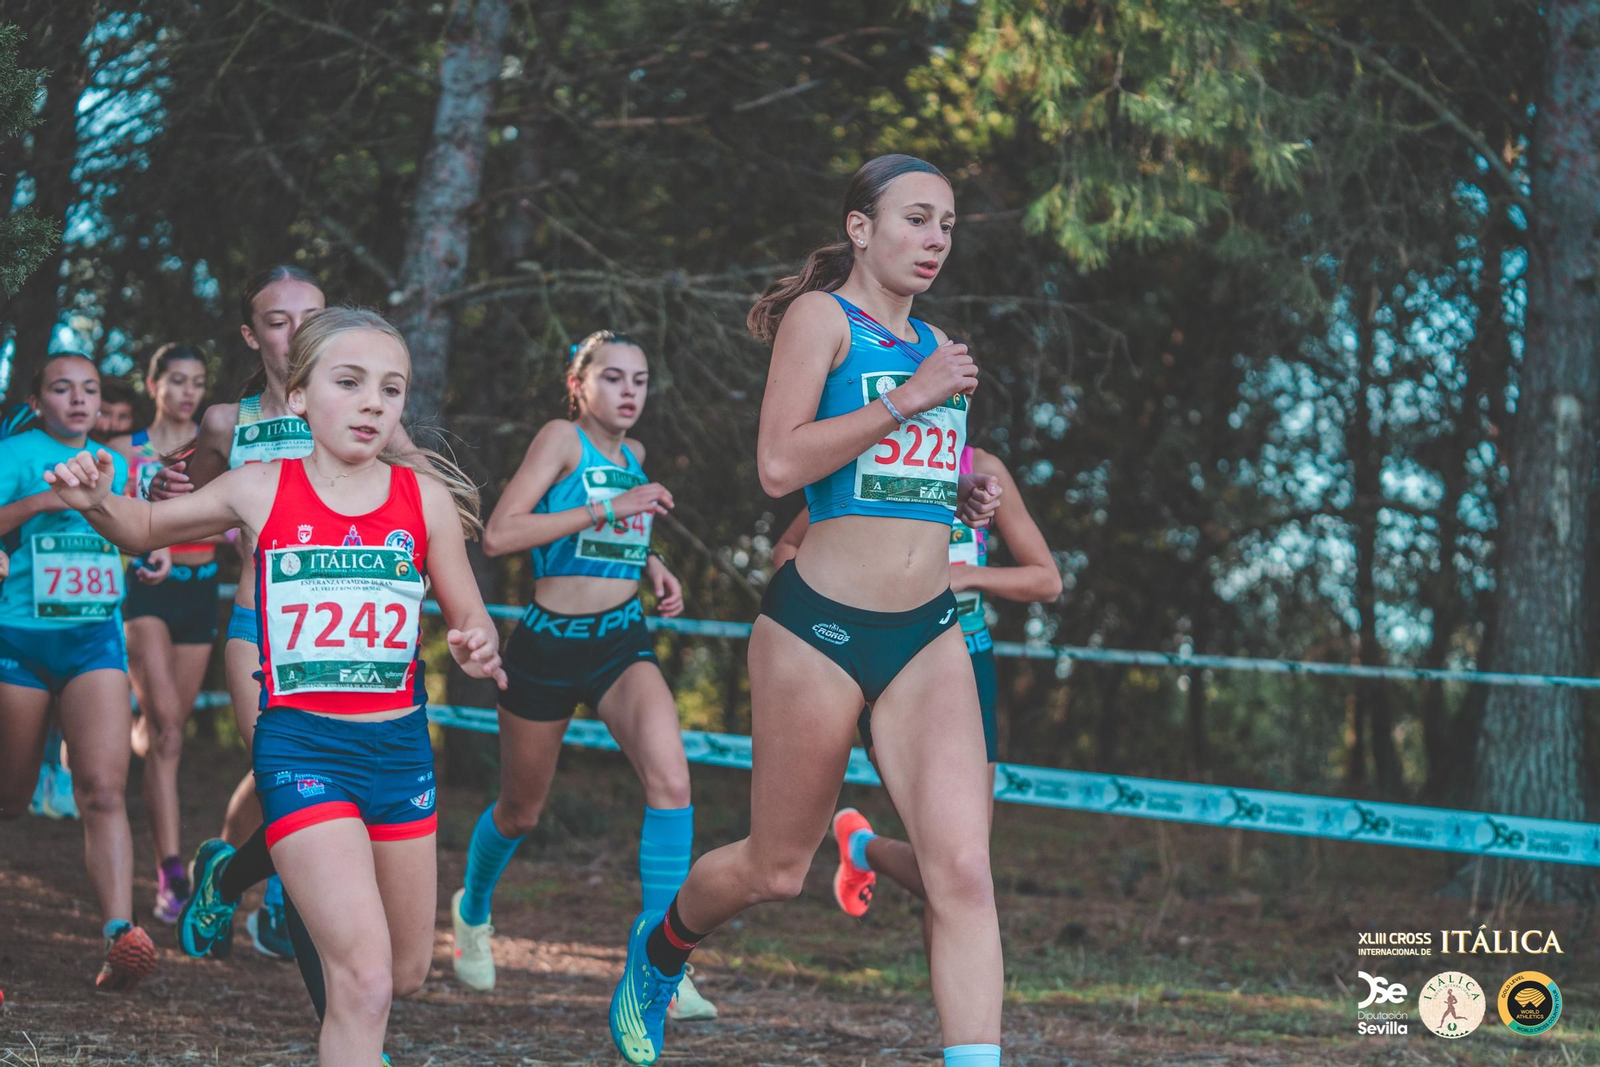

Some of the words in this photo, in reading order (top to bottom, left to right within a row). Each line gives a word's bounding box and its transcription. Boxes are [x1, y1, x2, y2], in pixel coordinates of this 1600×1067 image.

[875, 424, 957, 471] 5223
[310, 551, 385, 569] ITÁLICA
[43, 567, 119, 595] 7381
[281, 601, 408, 650] 7242
